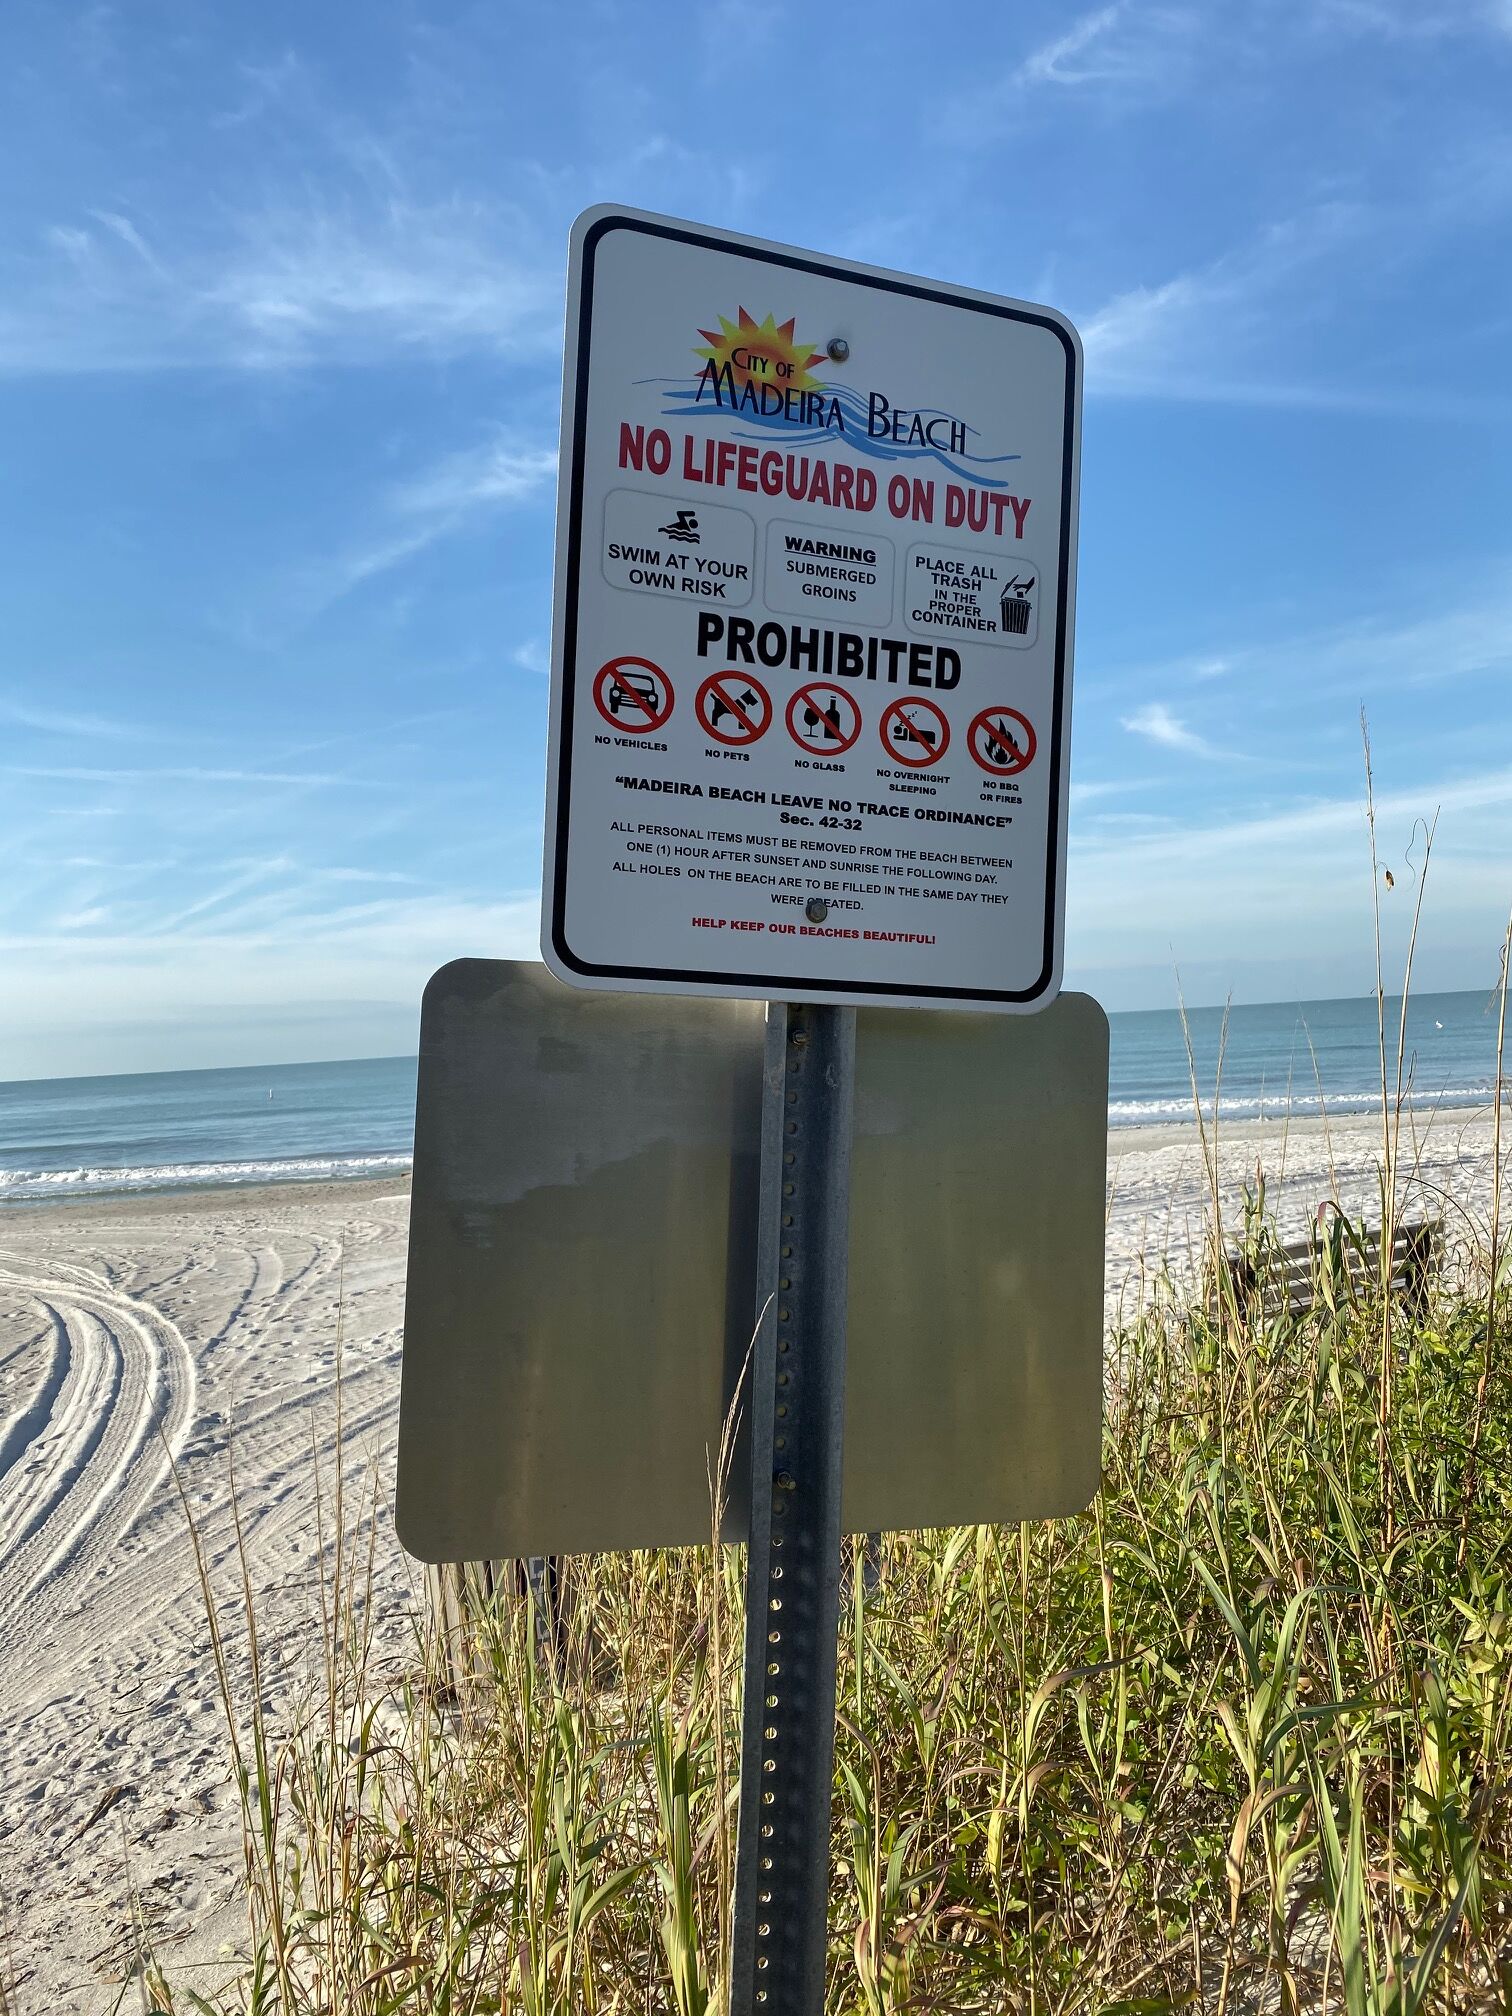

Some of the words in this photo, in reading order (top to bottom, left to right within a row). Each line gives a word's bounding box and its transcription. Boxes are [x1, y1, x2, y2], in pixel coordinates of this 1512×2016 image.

[776, 362, 795, 379] OF
[619, 422, 671, 475] NO
[683, 435, 877, 512] LIFEGUARD
[888, 474, 934, 523] ON
[945, 484, 1031, 539] DUTY
[784, 536, 876, 563] WARNING
[608, 544, 660, 565] SWIM
[665, 553, 689, 570] AT
[695, 558, 748, 580] YOUR
[915, 556, 964, 575] PLACE
[971, 565, 997, 580] ALL
[786, 561, 876, 585] SUBMERGED
[931, 573, 982, 591] TRASH
[629, 569, 675, 590] OWN
[682, 577, 726, 598] RISK
[802, 583, 857, 602] GROINS
[934, 589, 947, 600] IN
[953, 592, 977, 605] THE
[929, 601, 981, 617] PROPER
[912, 610, 996, 633] CONTAINER
[697, 612, 961, 690] PROHIBITED
[594, 735, 611, 744] NO
[614, 737, 668, 752] VEHICLES
[705, 749, 720, 758] NO
[723, 751, 750, 761] PETS
[794, 760, 809, 769] NO
[812, 761, 845, 772] GLASS
[876, 769, 891, 778] NO
[893, 770, 950, 783] OVERNIGHT
[889, 784, 936, 796] SLEEPING
[983, 781, 997, 789] NO
[999, 782, 1019, 792] BBQ
[709, 787, 765, 803] BEACH
[771, 793, 823, 810] LEAVE
[828, 799, 851, 812] NO
[857, 802, 909, 818] TRACE
[979, 793, 993, 802] OR
[996, 795, 1022, 804] FIRES
[780, 812, 814, 826] Sec.
[819, 816, 862, 831] 42-32
[610, 821, 634, 832] ALL
[638, 824, 703, 840] PERSONAL
[707, 832, 742, 843] ITEMS
[746, 835, 778, 847] MUST
[782, 839, 797, 849] BE
[801, 841, 856, 854] REMOVED
[860, 846, 892, 858] FROM
[895, 849, 916, 860] THE
[920, 852, 957, 863] BEACH
[960, 855, 1013, 868] BETWEEN
[627, 842, 652, 853] ONE
[656, 844, 671, 857] (1)
[674, 846, 709, 859] HOUR
[712, 851, 750, 862] AFTER
[754, 854, 800, 867] SUNSET
[802, 859, 827, 869] AND
[830, 861, 879, 874] SUNRISE
[882, 866, 903, 876] THE
[907, 868, 972, 882] FOLLOWING
[975, 874, 997, 884] DAY.
[613, 862, 636, 873] ALL
[640, 864, 681, 877] HOLES
[687, 868, 705, 879] ON
[709, 870, 732, 881] THE
[735, 873, 776, 885] BEACH
[778, 877, 802, 888] ARE
[805, 879, 820, 889] TO
[823, 881, 839, 891] BE
[842, 882, 881, 894] FILLED
[884, 885, 895, 895] IN
[898, 887, 919, 897] THE
[923, 889, 953, 900] SAME
[957, 892, 978, 902] DAY
[981, 894, 1009, 904] THEY
[771, 894, 804, 906] WERE
[692, 917, 726, 929] HELP
[730, 921, 765, 932] KEEP
[769, 924, 796, 934] OUR
[799, 926, 860, 939] BEACHES
[863, 931, 936, 944] BEAUTIFUL!
